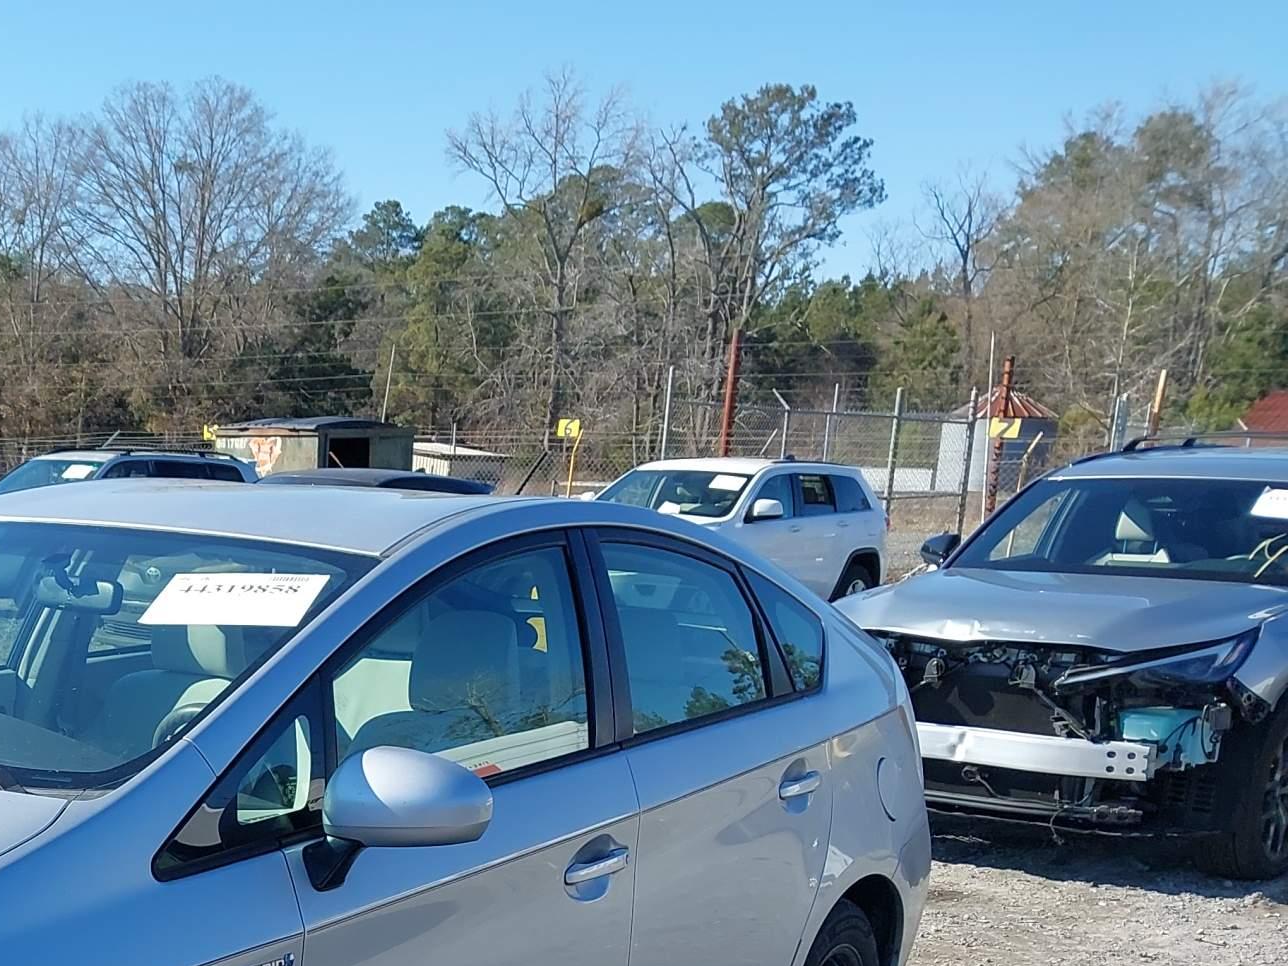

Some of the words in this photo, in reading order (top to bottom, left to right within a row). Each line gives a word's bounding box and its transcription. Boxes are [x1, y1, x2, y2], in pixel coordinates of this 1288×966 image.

[565, 418, 575, 437] 6
[996, 417, 1015, 438] 7
[179, 584, 301, 595] 44319858
